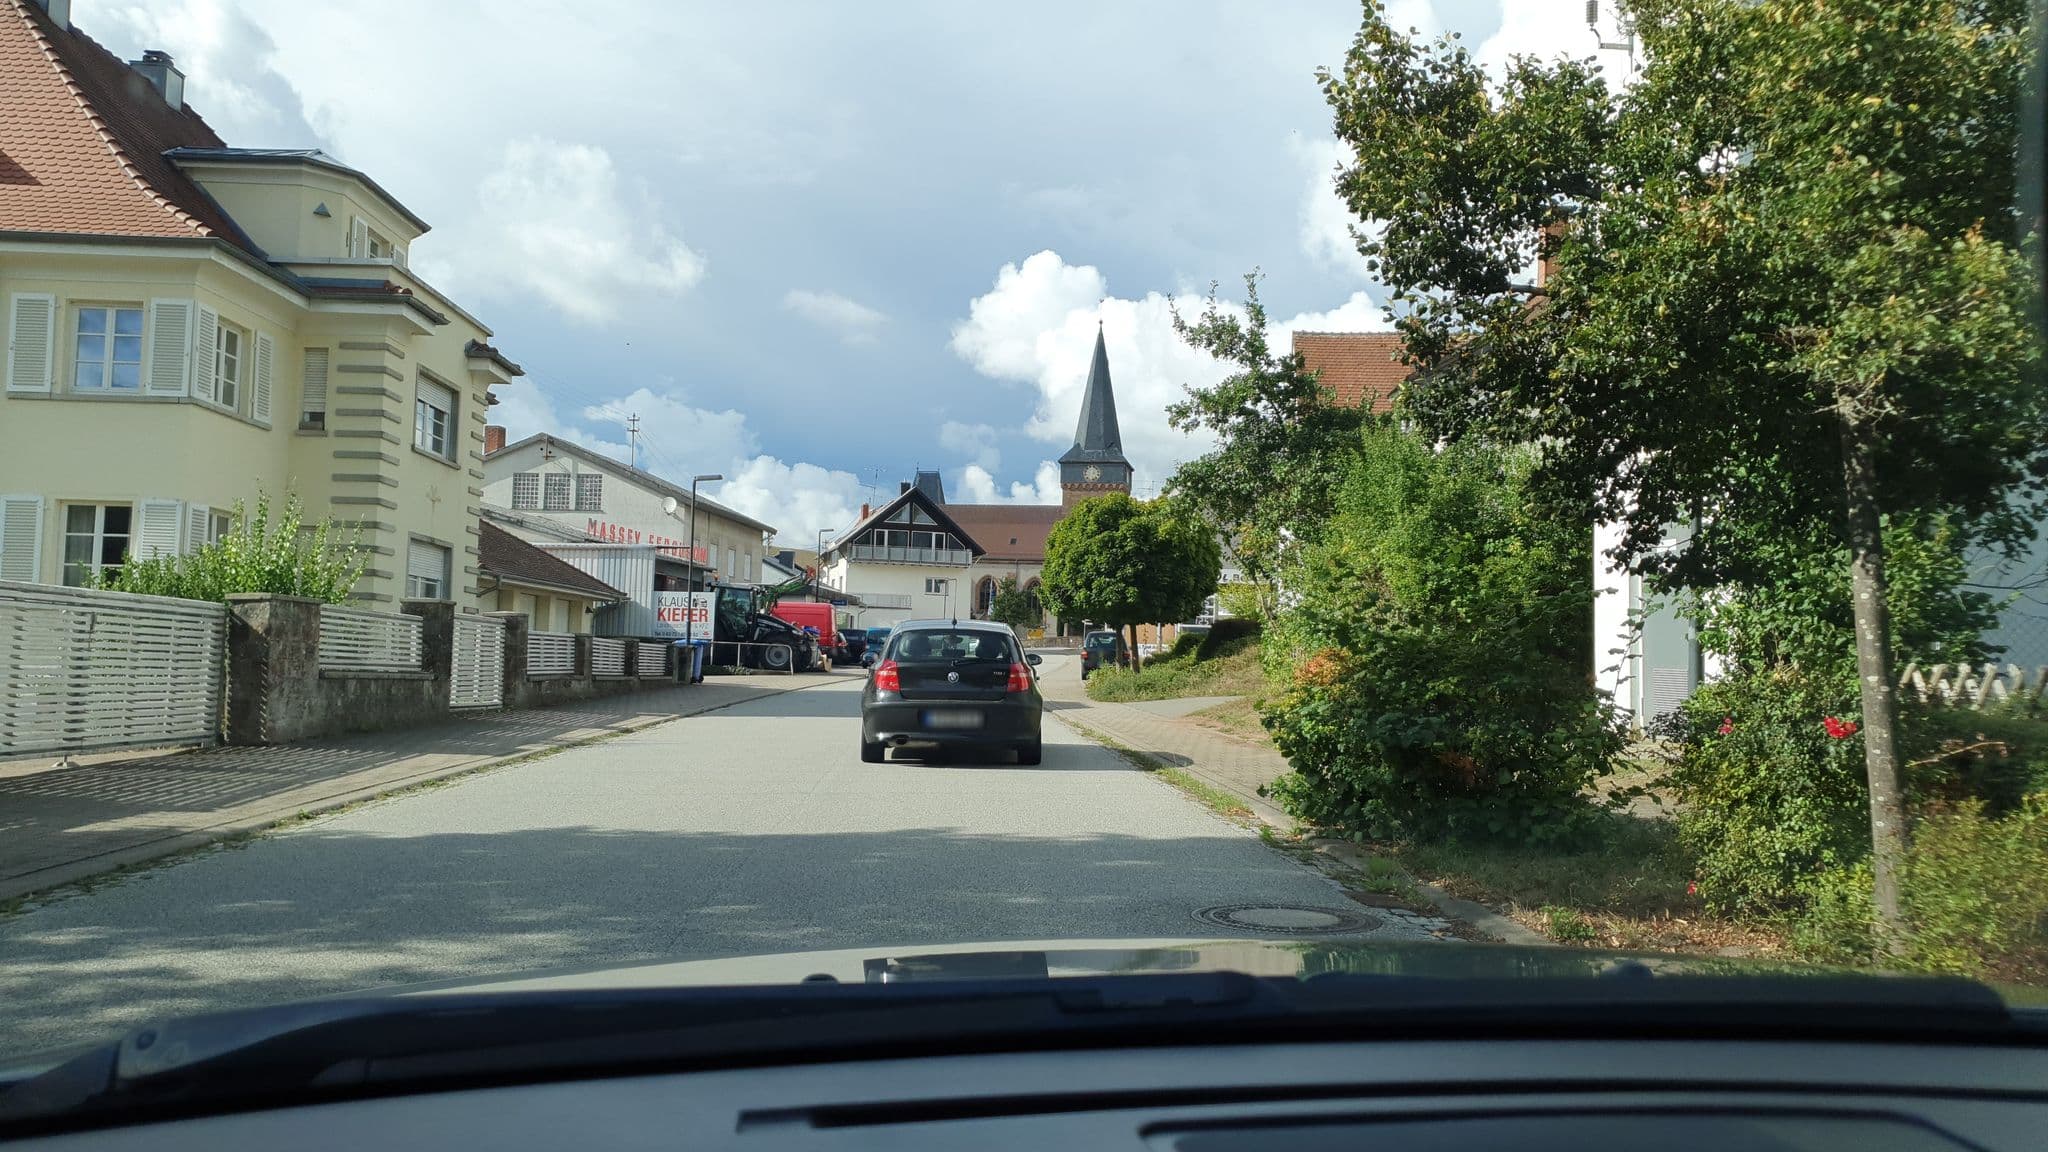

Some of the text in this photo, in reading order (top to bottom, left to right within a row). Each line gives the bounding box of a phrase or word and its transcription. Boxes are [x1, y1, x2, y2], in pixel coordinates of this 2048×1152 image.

[587, 517, 641, 545] MASSEY
[657, 596, 689, 607] KLAUS
[657, 607, 709, 622] KIEFER
